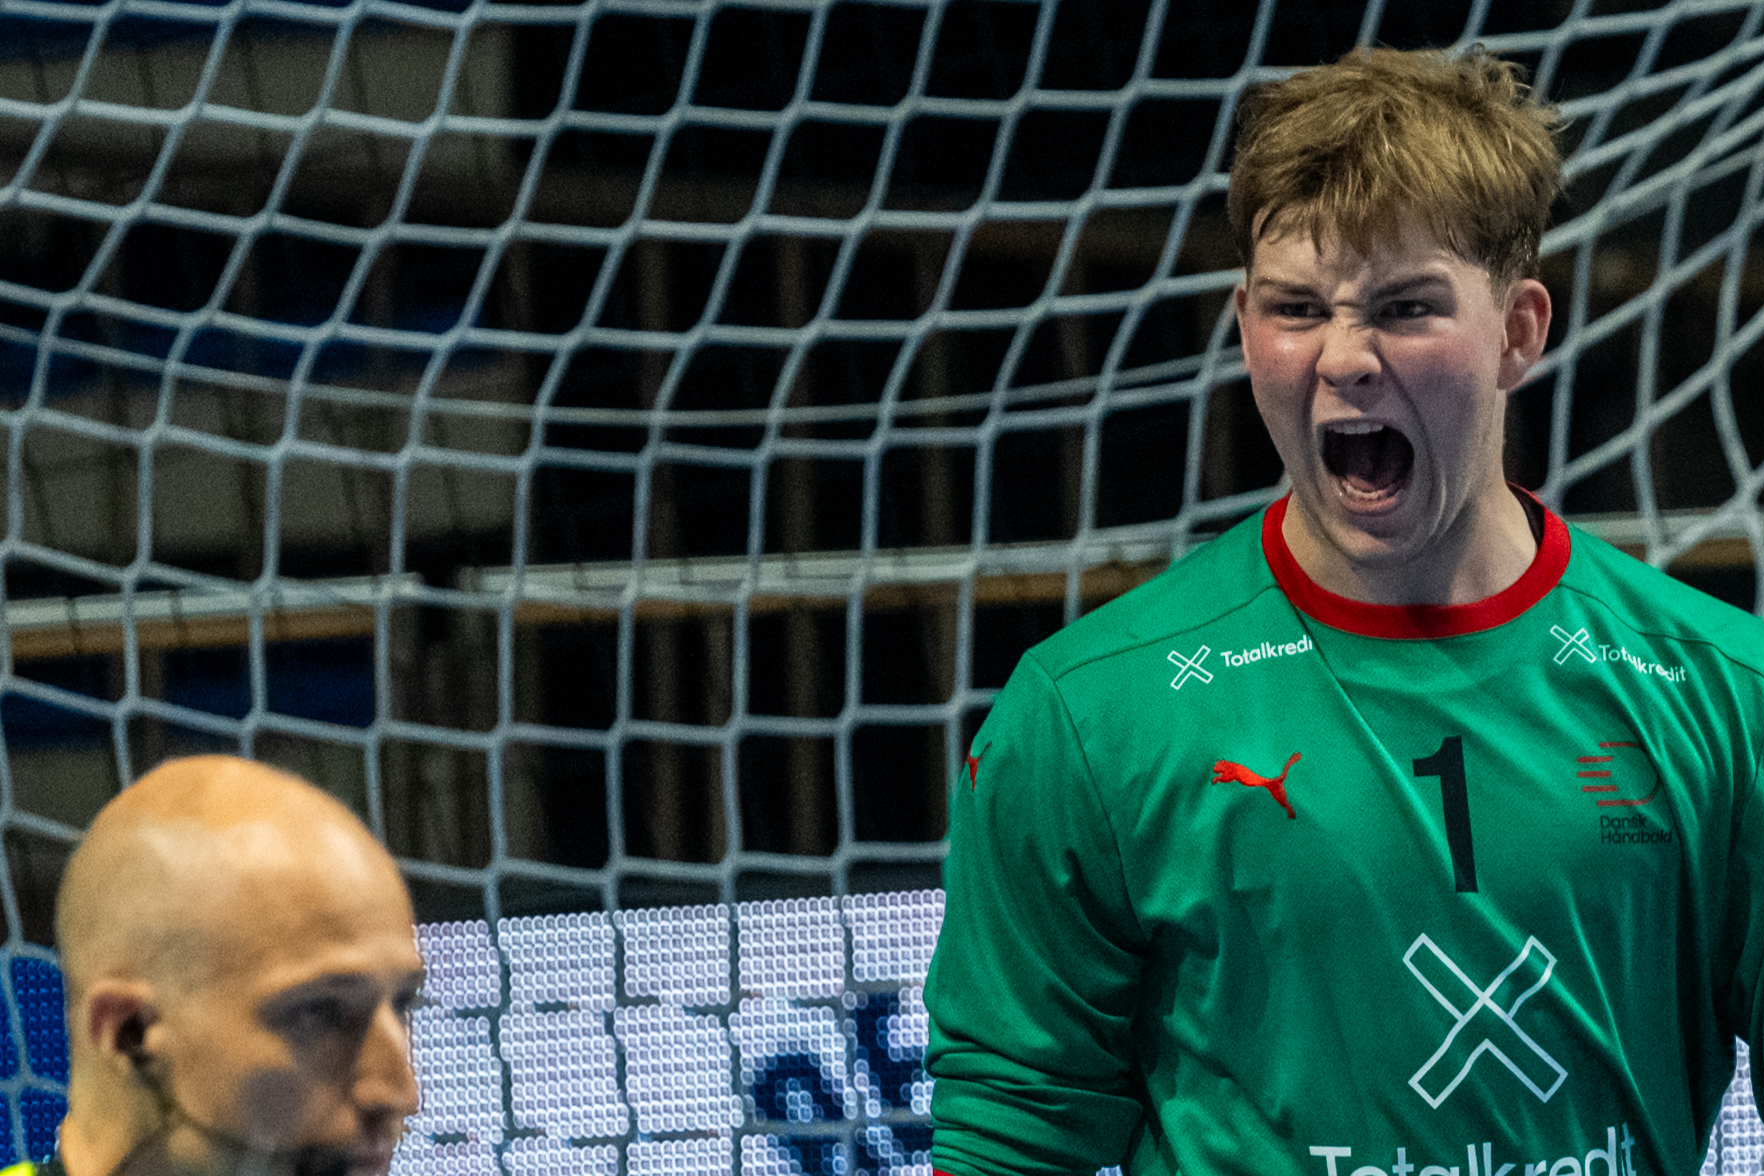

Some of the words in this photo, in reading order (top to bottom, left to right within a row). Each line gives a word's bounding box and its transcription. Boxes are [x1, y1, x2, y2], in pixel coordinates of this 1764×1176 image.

[1220, 634, 1313, 667] Totalkredi
[1412, 735, 1479, 893] 1
[1600, 815, 1646, 829] Dansk
